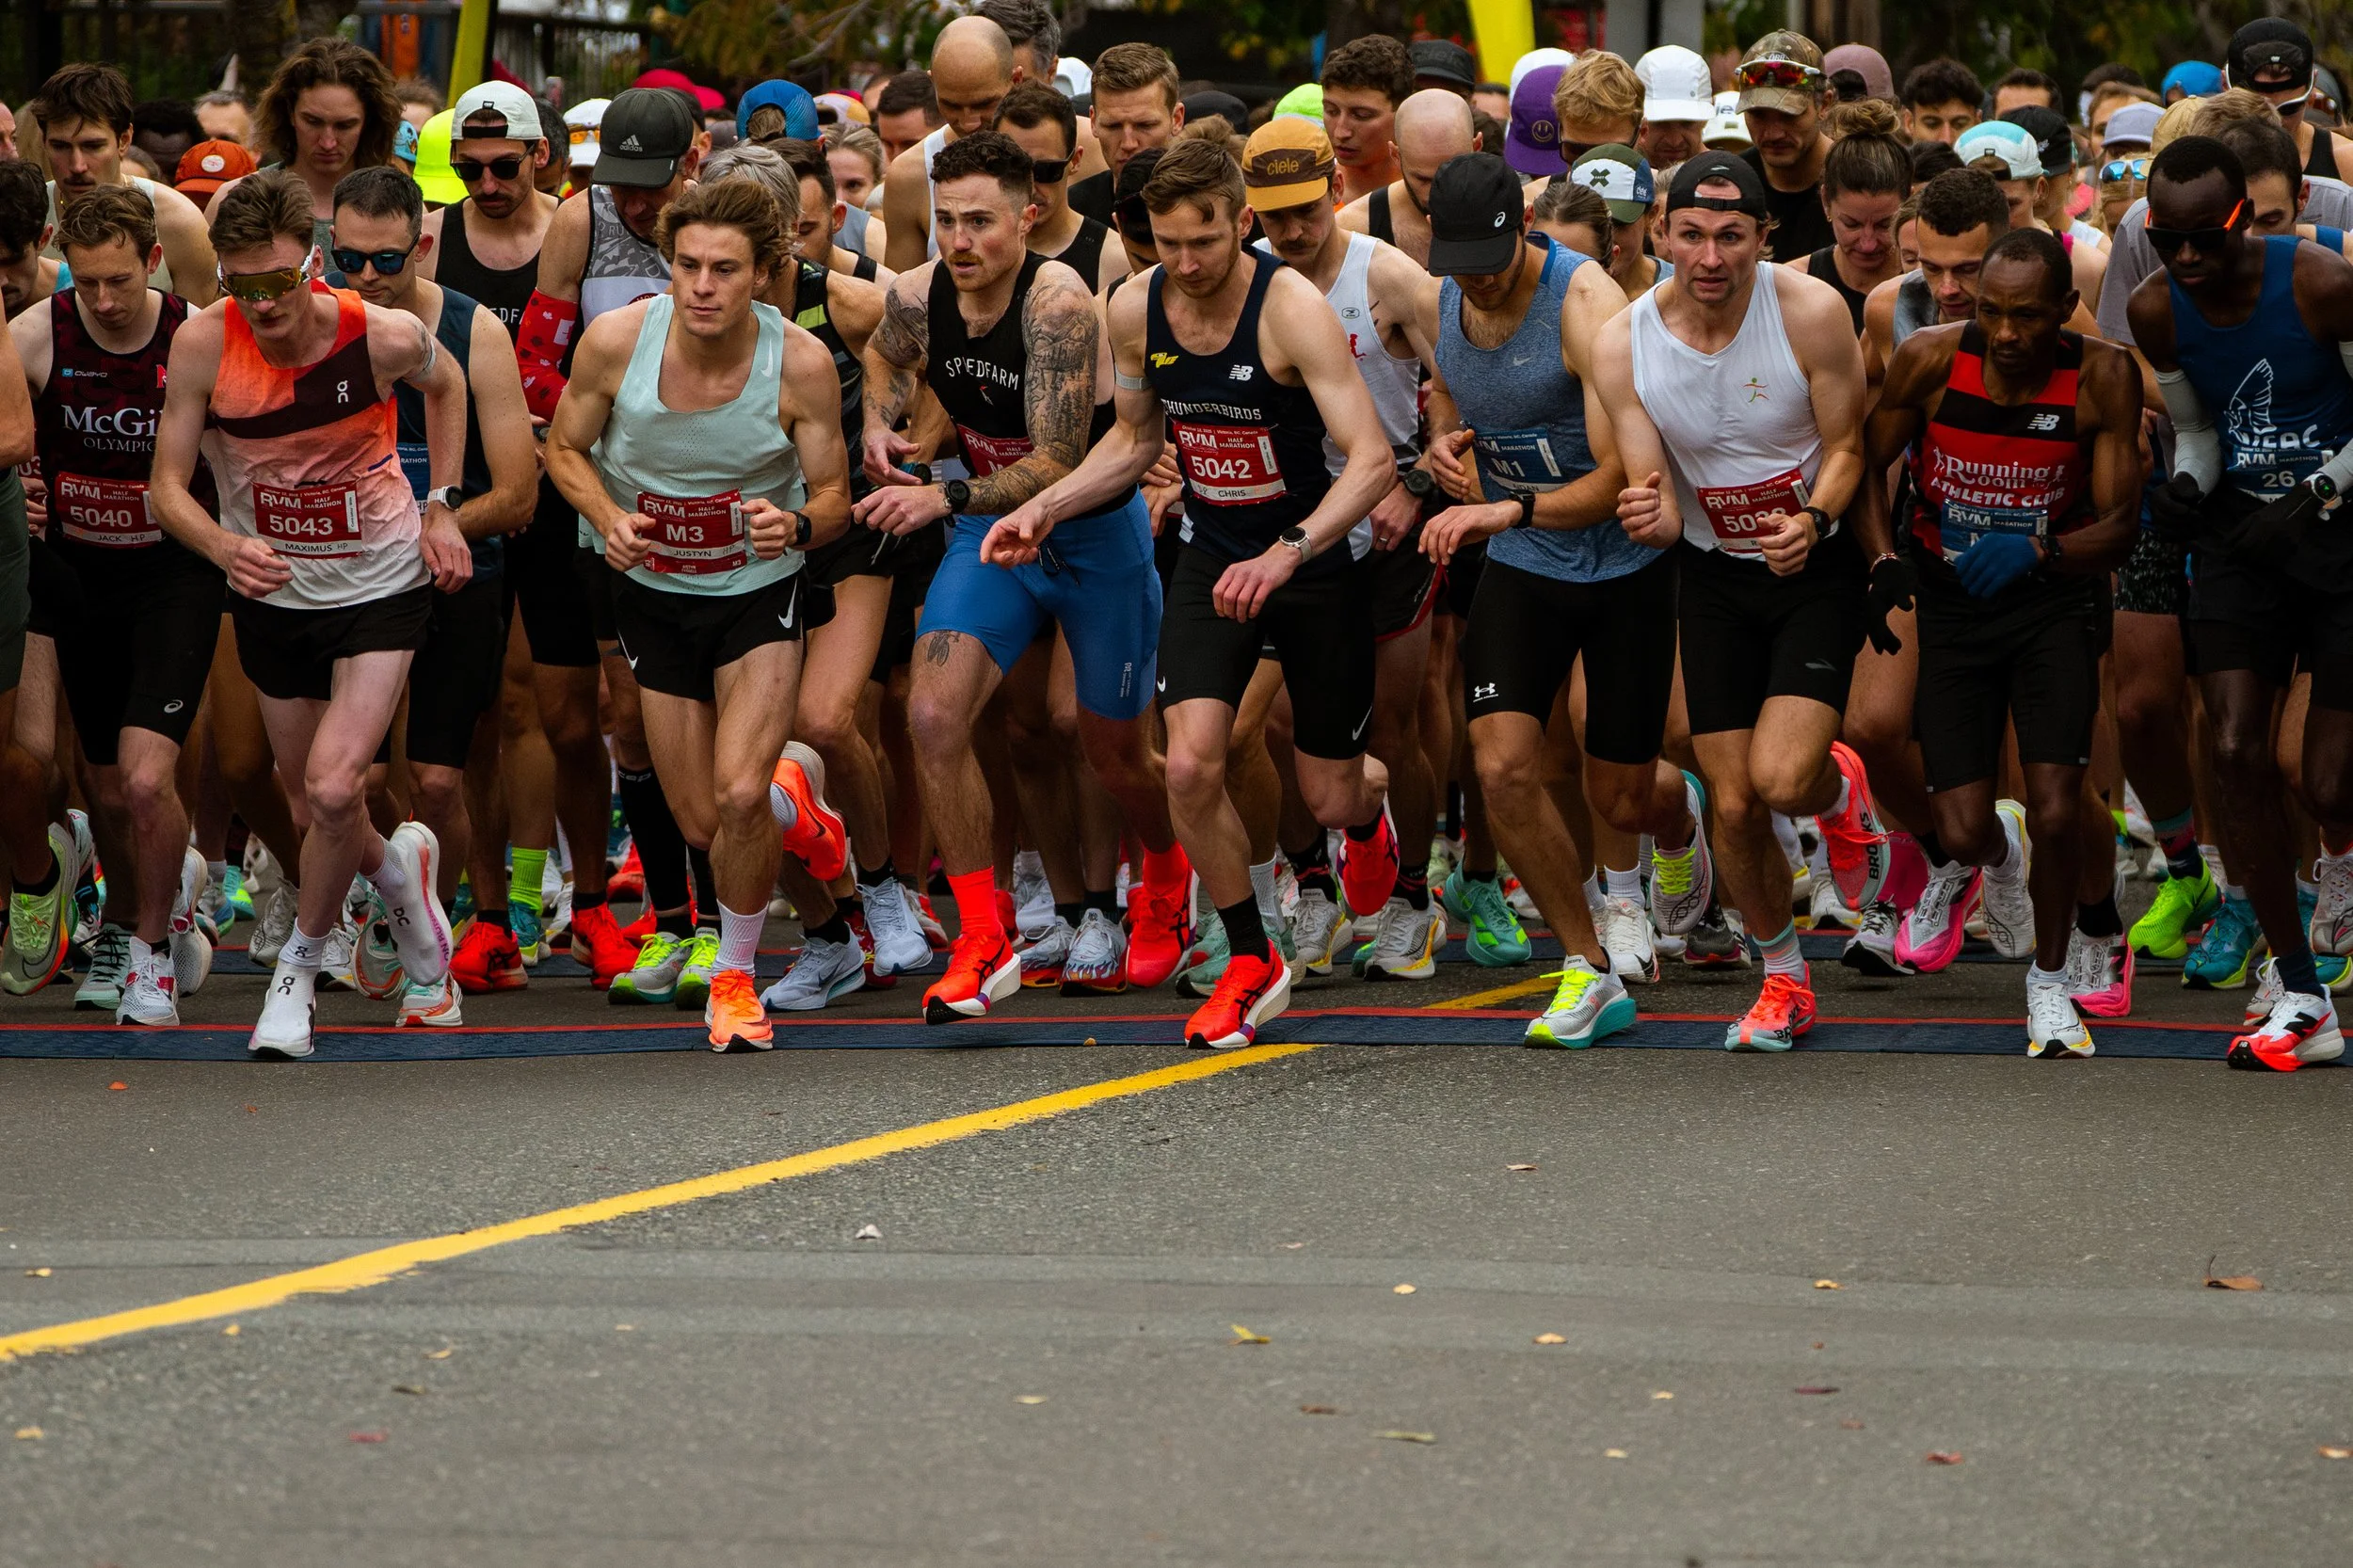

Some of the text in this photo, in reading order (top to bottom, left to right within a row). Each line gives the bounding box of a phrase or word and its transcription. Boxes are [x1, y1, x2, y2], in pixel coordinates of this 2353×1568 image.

[1267, 158, 1299, 176] ciele
[945, 357, 1018, 391] SPEDFARM
[1160, 398, 1262, 421] THUNDERBIRDS
[61, 405, 163, 437] McGi
[965, 433, 998, 456] RVM
[1178, 430, 1218, 450] RVM
[1191, 455, 1253, 480] 5042
[1491, 457, 1526, 478] M1
[1945, 454, 2051, 485] Running
[2262, 471, 2296, 488] 26
[61, 481, 101, 500] RVM
[260, 491, 301, 509] RVM
[1218, 489, 1246, 498] CHRIS
[1752, 490, 1790, 503] MARATHON
[1930, 476, 2065, 507] ATHLETIC CLUB
[304, 500, 342, 509] MARATHON
[644, 500, 685, 519] RVM
[1705, 493, 1750, 509] RVM
[70, 505, 133, 527] 5040
[688, 509, 727, 518] MARATHON
[1948, 507, 1991, 526] RVM
[269, 513, 333, 536] 5043
[665, 523, 704, 543] M3
[285, 543, 332, 552] MAXIMUS
[1859, 812, 1880, 880] BROKS
